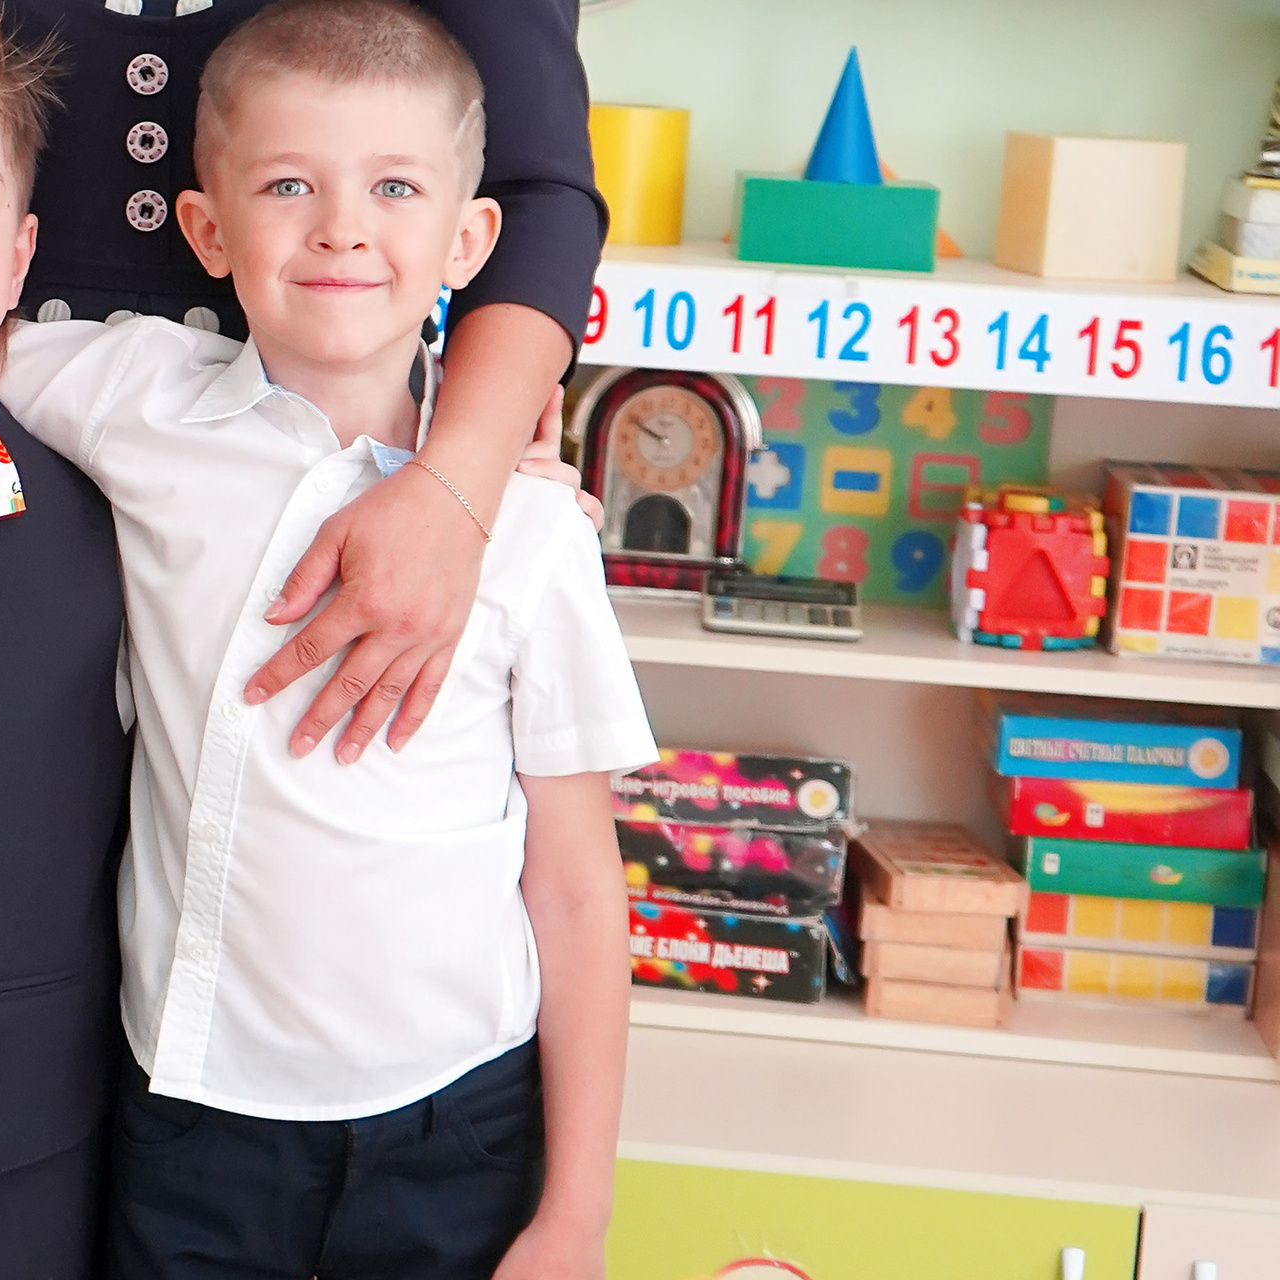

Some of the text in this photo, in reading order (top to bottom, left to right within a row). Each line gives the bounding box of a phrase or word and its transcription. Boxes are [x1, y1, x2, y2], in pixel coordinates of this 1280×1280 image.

[582, 285, 1280, 388] 9 10 11 12 13 14 15 16 1
[756, 376, 1032, 445] 2 3 4 5
[751, 519, 944, 595] 7 8 9
[656, 936, 712, 965] БЛОКИ
